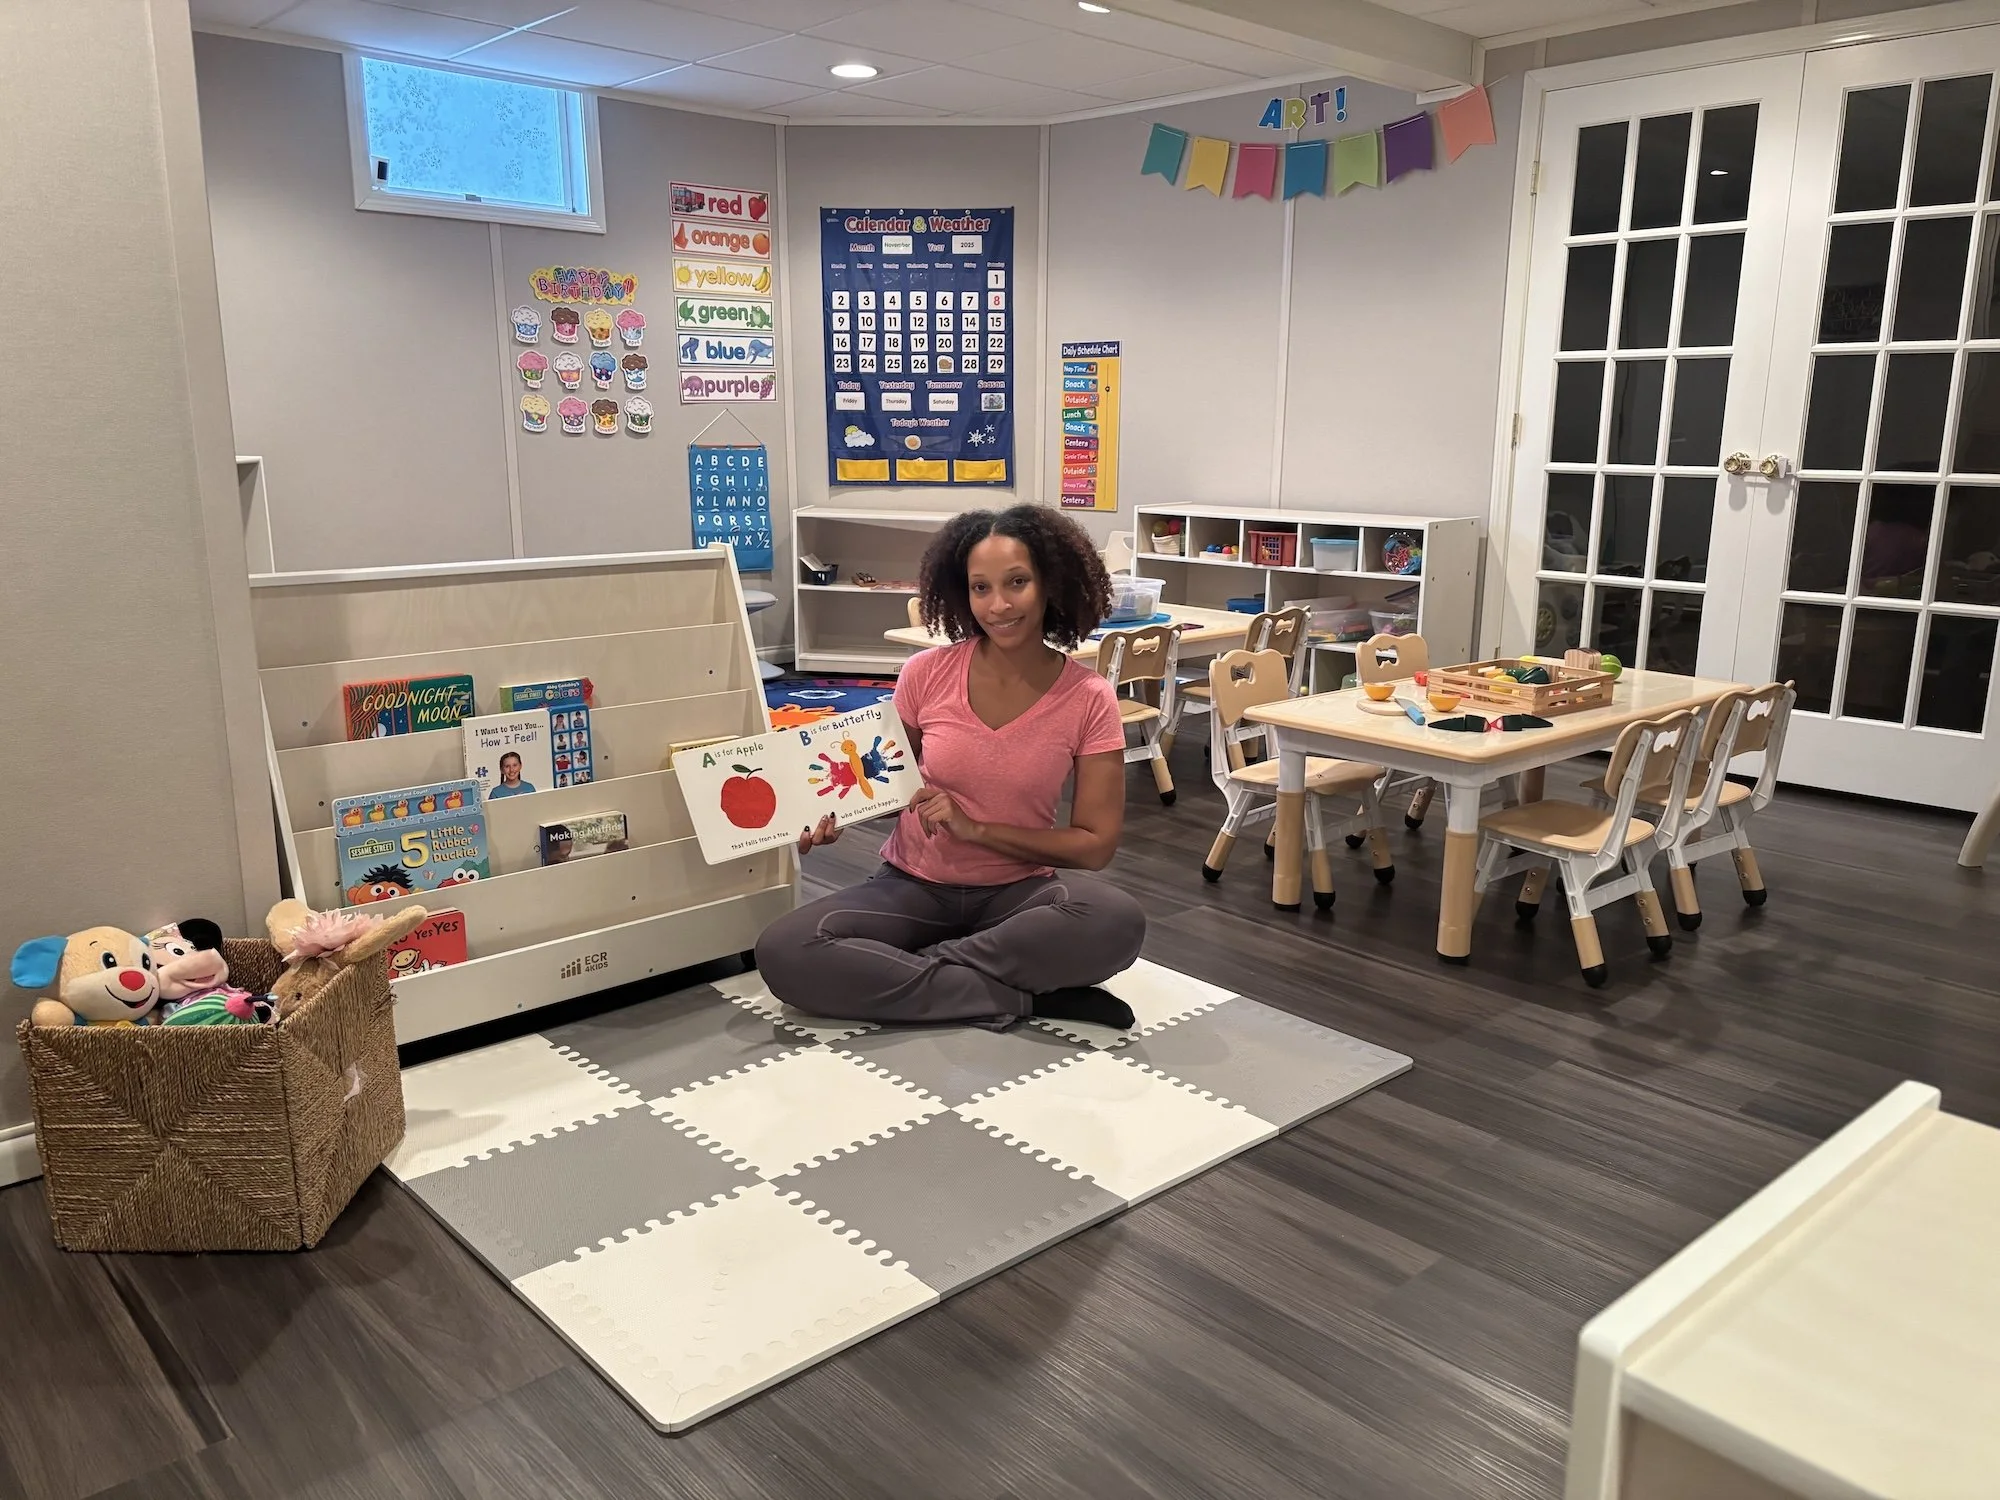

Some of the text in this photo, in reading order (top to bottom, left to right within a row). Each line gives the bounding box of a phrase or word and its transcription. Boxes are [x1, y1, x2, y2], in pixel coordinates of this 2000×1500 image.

[1257, 86, 1347, 131] ART!
[709, 194, 742, 215] red
[845, 216, 990, 233] Calendar & Weather
[692, 229, 750, 253] orange
[850, 243, 875, 252] Month
[927, 243, 945, 252] Year
[554, 269, 608, 286] HAPPY
[695, 266, 752, 288] yellow
[994, 274, 999, 284] 1
[538, 277, 632, 299] BIRTHDAY!
[838, 295, 1000, 306] 2 3 4 5 6 7 8
[698, 305, 748, 324] green
[838, 316, 1002, 328] 9 10 11 12 13 14 15
[836, 337, 1003, 348] 16 17 18 19 20 21 22
[706, 340, 745, 360] blue
[1063, 344, 1118, 357] Daily Schedule Chart
[836, 358, 1003, 370] 23 24 25 26 28 29
[704, 375, 760, 397] purple
[837, 380, 1005, 391] Today Yesterday Tomorrow Season
[1065, 380, 1085, 389] Snack
[1065, 395, 1088, 404] Outside
[1063, 410, 1081, 419] Lunch
[890, 418, 950, 428] Today's Weather
[1065, 423, 1085, 432] Snack
[1065, 439, 1088, 447] Centers
[695, 454, 764, 467] A B C D E
[1063, 467, 1086, 475] Outside
[696, 474, 763, 487] F G H I J
[696, 496, 766, 506] K L M N O
[1062, 496, 1085, 504] Centers
[698, 515, 767, 526] P Q R S T
[698, 536, 706, 547] U
[728, 536, 739, 546] W
[745, 535, 752, 546] X
[757, 532, 770, 548] Y/Z
[363, 686, 457, 712] GOODNIGHT
[545, 688, 580, 700] Colors
[417, 705, 462, 724] MOON
[480, 727, 498, 736] Want
[510, 723, 523, 732] Tell
[524, 722, 544, 730] You...
[800, 730, 811, 746] B
[819, 724, 830, 732] for
[832, 710, 882, 730] Butterfly
[481, 732, 537, 748] How I Feel!
[702, 752, 717, 768] A
[736, 742, 764, 757] Apple
[854, 804, 877, 815] flutters
[430, 825, 464, 840] Little
[550, 823, 621, 842] Making Muffins
[351, 843, 392, 857] SESAME STREET
[400, 831, 429, 868] 5
[431, 836, 472, 851] Rubber
[745, 839, 758, 847] falls
[432, 846, 479, 864] Duckies
[414, 929, 433, 940] Yes
[432, 921, 458, 935] Yes
[585, 951, 607, 965] ECR
[585, 961, 609, 972] 4KIDS
